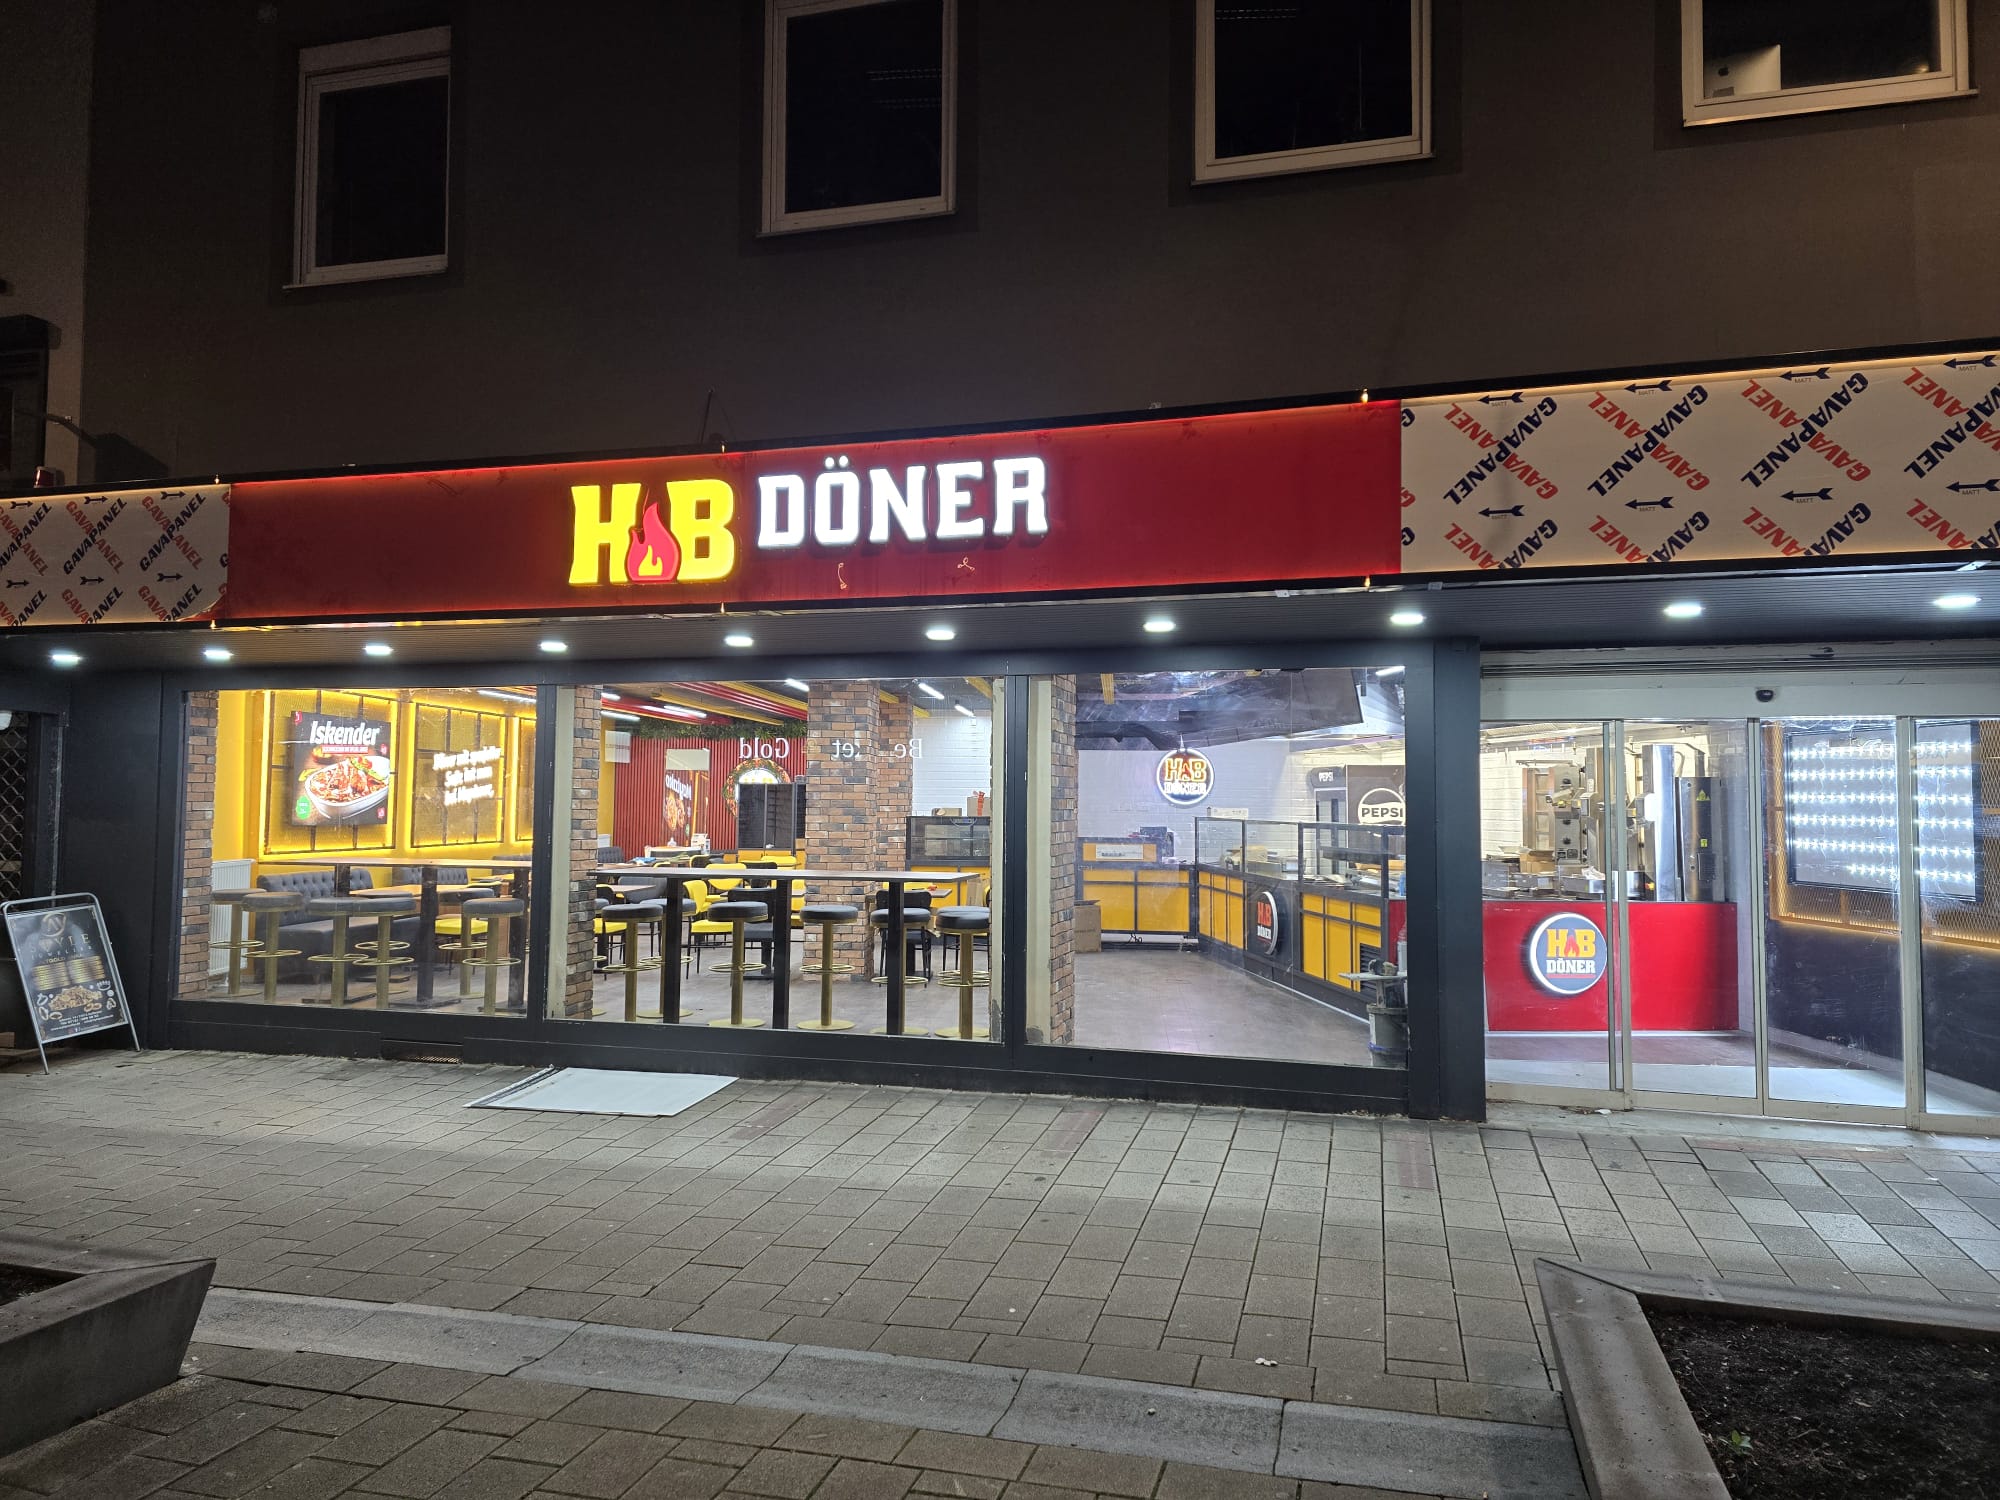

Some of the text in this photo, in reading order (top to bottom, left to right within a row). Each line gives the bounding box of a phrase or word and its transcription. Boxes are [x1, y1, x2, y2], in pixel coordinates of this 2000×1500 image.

[1443, 397, 1557, 504] GAVAPANEL
[1444, 403, 1558, 499] GAVAANEL
[1587, 385, 1708, 496] GAVAPANEL
[1588, 391, 1710, 491] GAVAANEL
[1740, 373, 1869, 488] GAVAPANEL
[1741, 378, 1871, 481] GAVAANEL
[63, 498, 127, 575] GAVAPANEL
[66, 501, 124, 574] GAVAANEL
[140, 493, 206, 571] GAVAPANEL
[142, 496, 203, 570] GAVAANEL
[758, 456, 1048, 548] DÖNER
[309, 720, 381, 746] Iskender
[1361, 807, 1404, 818] PEPSI
[1546, 957, 1596, 975] DÖNER
